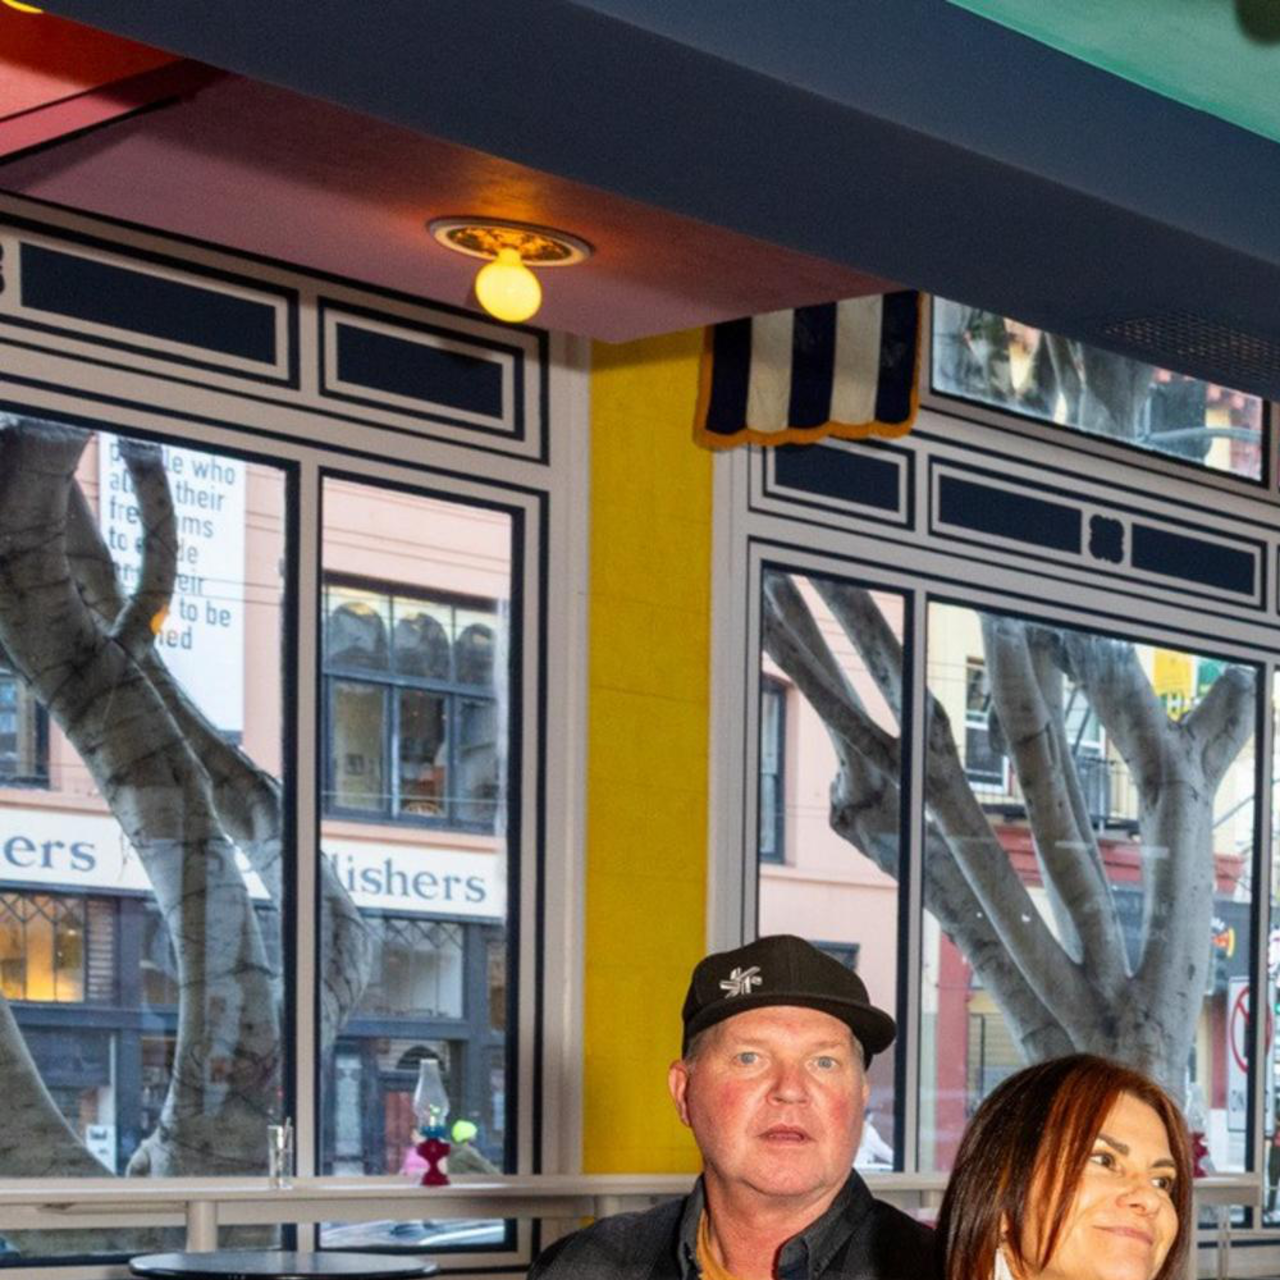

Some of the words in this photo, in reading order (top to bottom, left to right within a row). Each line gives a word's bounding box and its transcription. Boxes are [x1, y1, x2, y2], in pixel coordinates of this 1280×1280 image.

[192, 456, 236, 486] who
[176, 480, 224, 511] their
[179, 597, 198, 623] to
[206, 600, 231, 628] be
